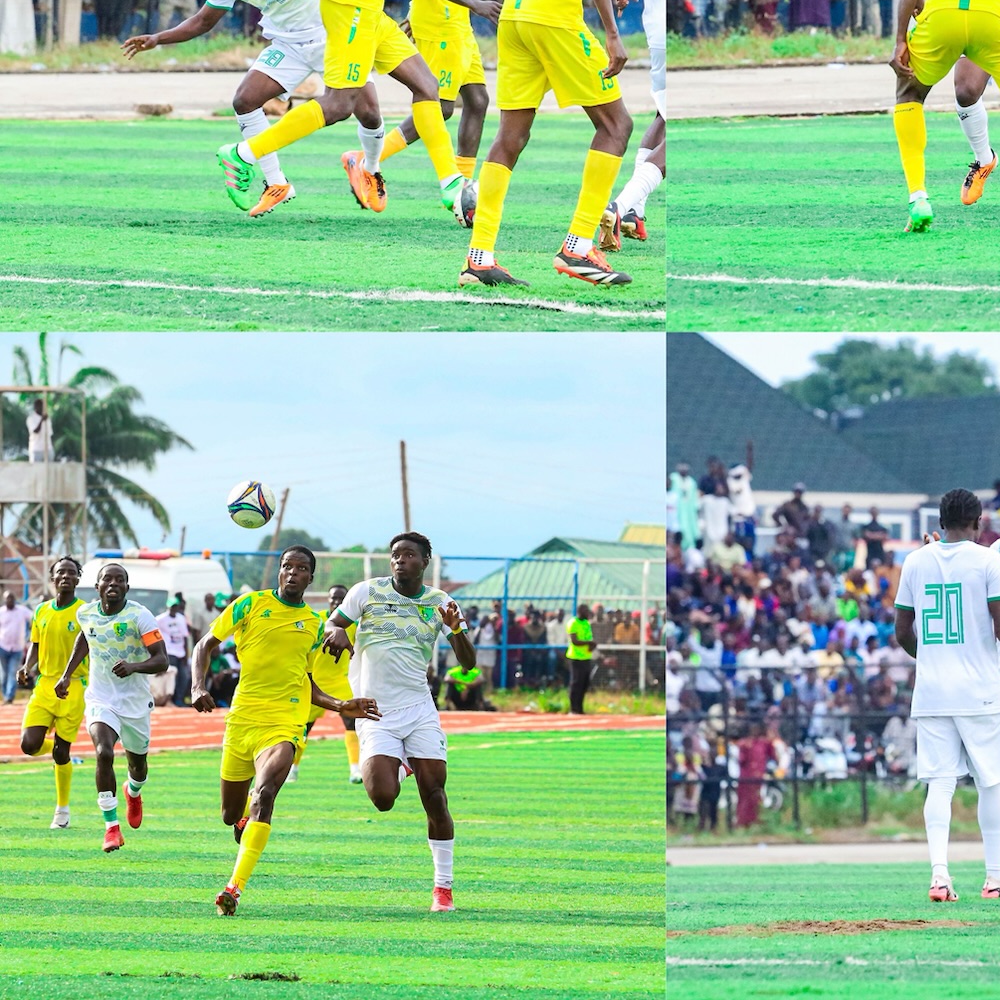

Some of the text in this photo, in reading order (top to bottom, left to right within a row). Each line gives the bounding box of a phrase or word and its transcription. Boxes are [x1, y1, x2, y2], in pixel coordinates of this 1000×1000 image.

[346, 63, 361, 82] 15
[438, 69, 452, 88] 24
[922, 582, 965, 645] 20
